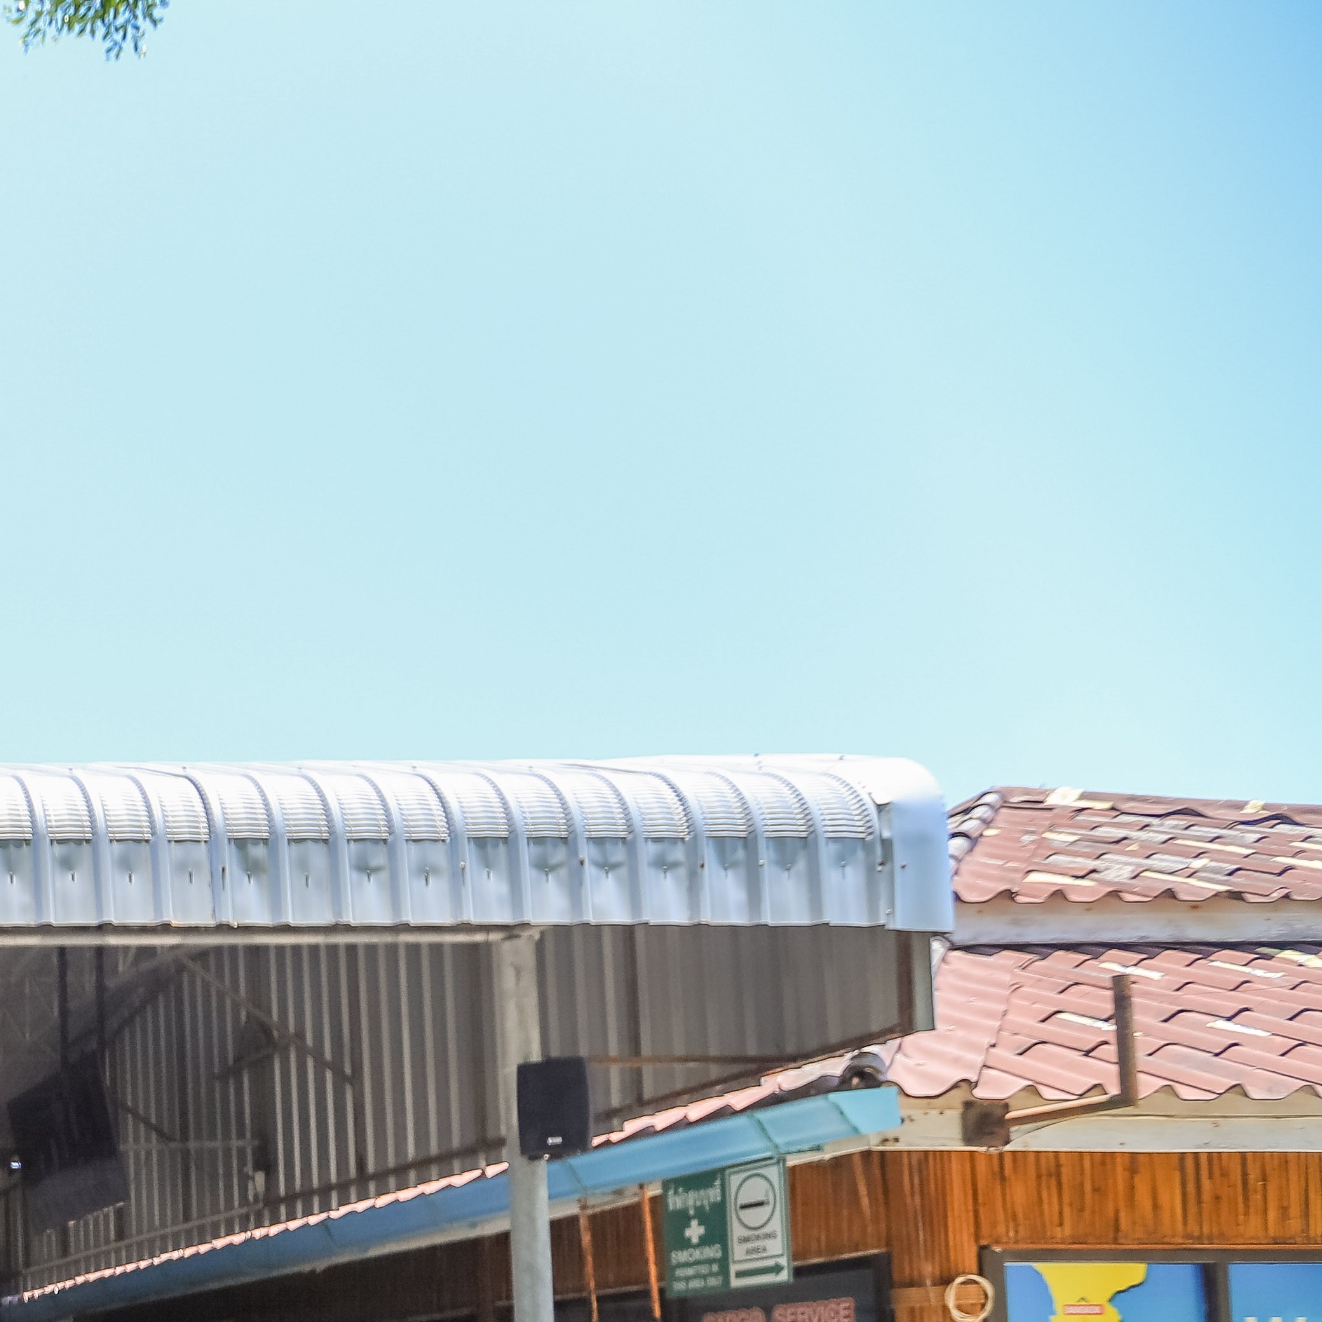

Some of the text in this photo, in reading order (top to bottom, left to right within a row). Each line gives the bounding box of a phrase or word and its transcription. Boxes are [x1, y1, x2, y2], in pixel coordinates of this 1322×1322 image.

[737, 1229, 778, 1245] SMOKING
[670, 1243, 722, 1267] SMOKING
[745, 1244, 768, 1256] AREA
